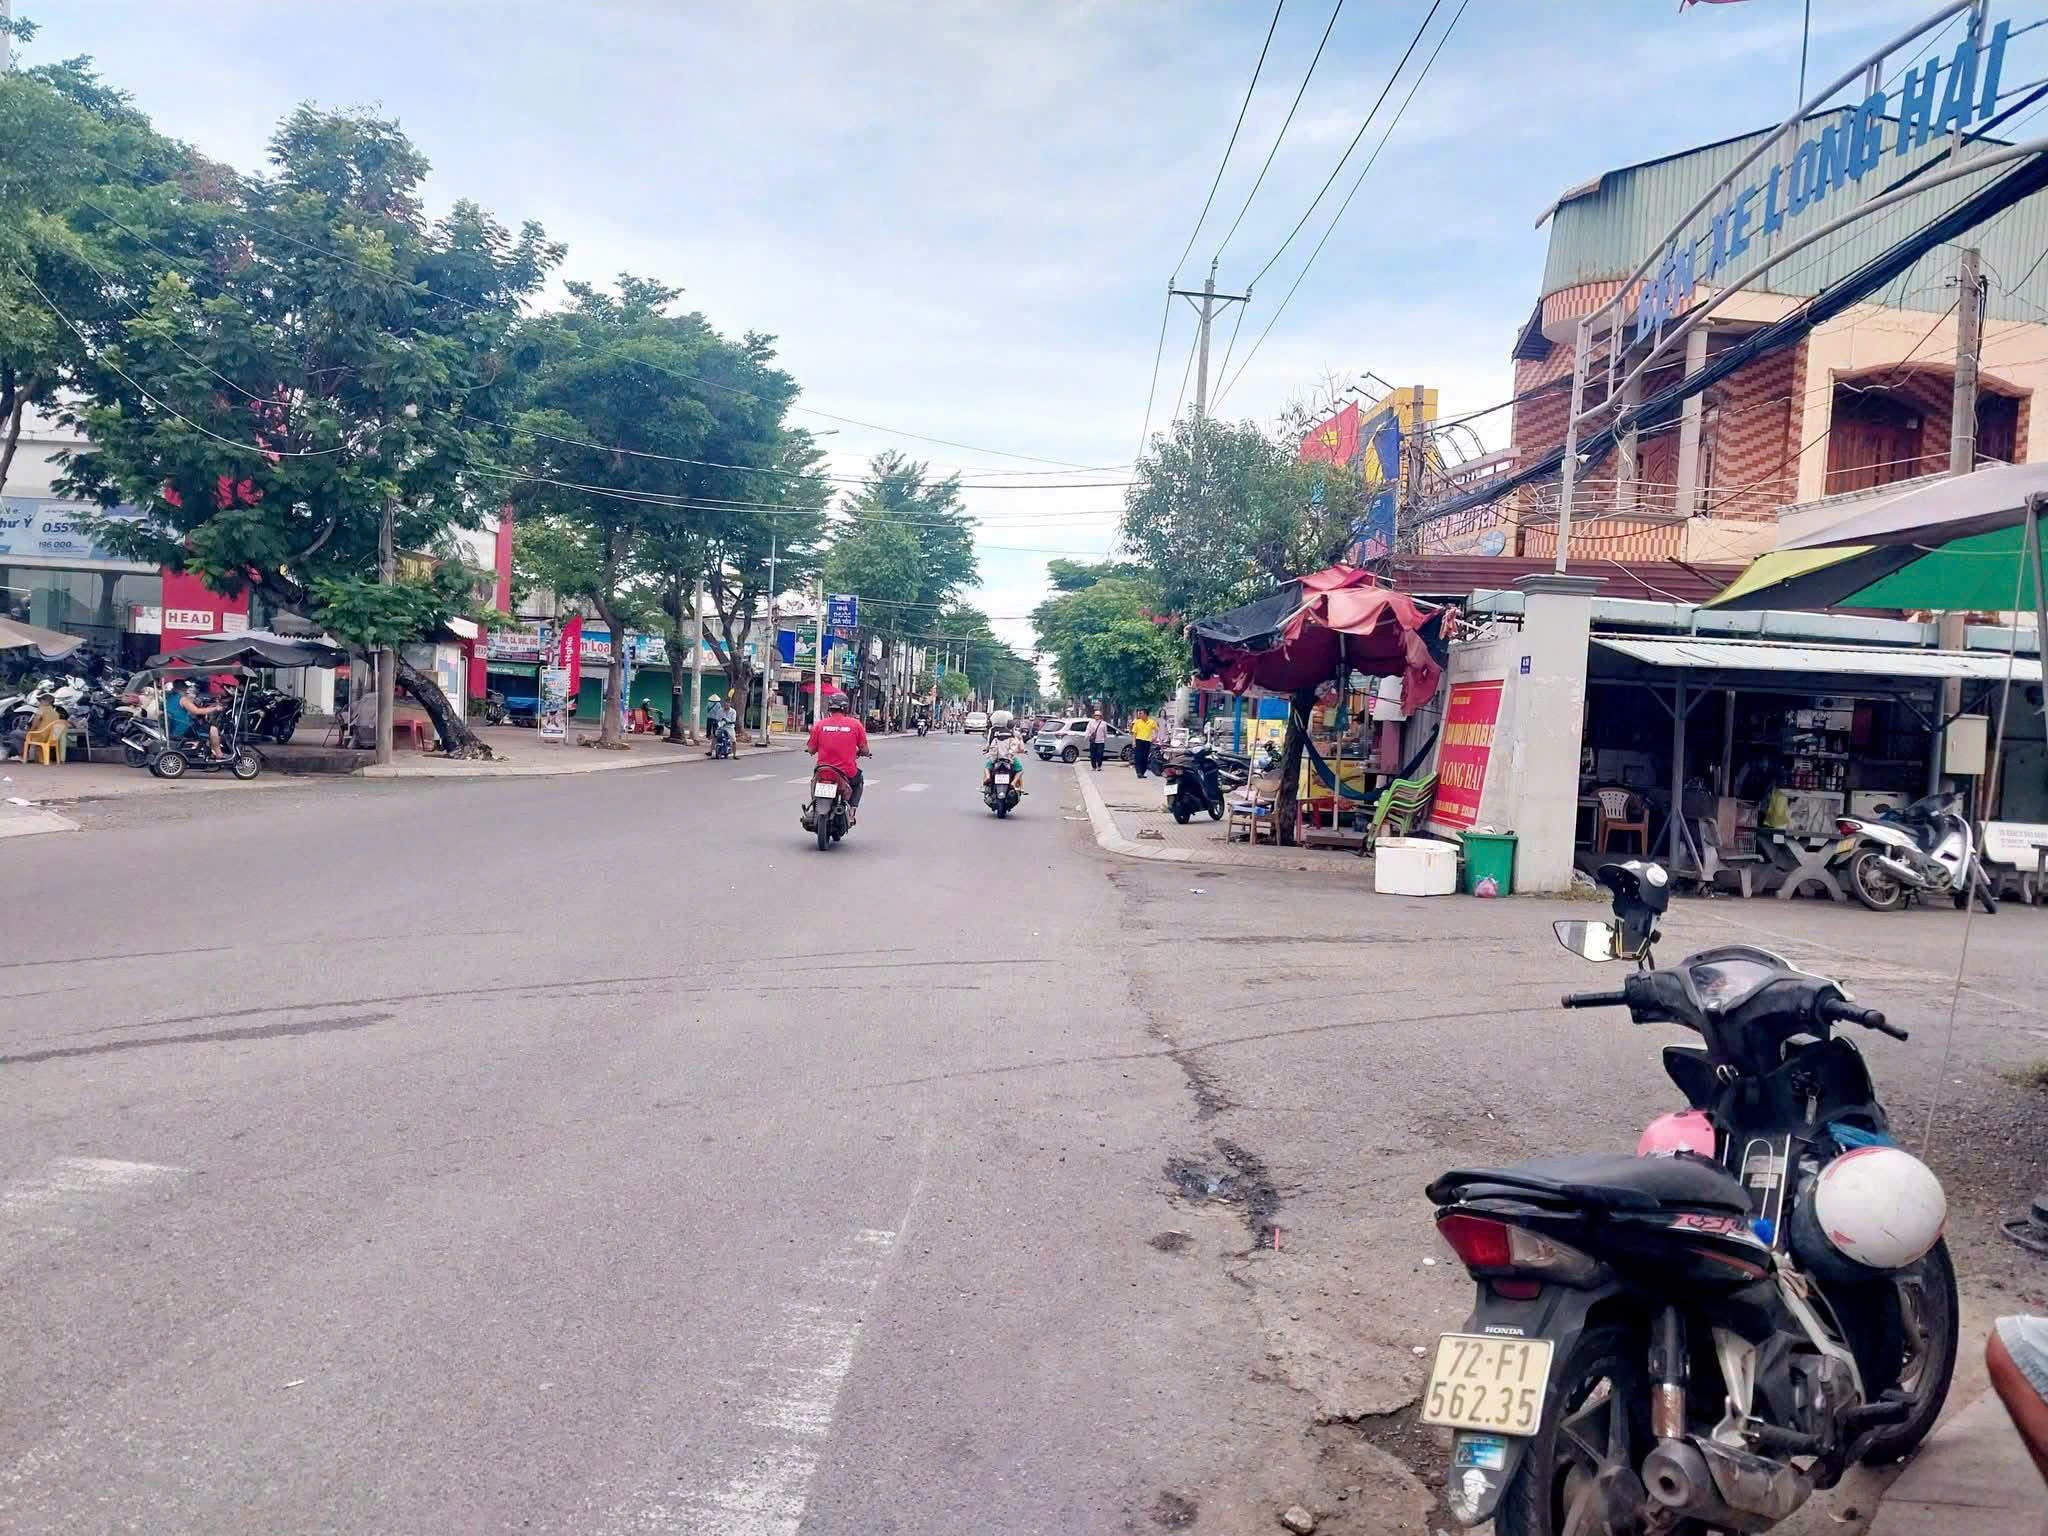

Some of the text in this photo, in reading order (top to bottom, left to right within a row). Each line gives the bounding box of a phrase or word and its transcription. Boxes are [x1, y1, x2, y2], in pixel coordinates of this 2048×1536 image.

[1638, 15, 2011, 344] BẾN XE LONG HẢI
[168, 612, 211, 624] HEAD
[1440, 761, 1465, 788] LONG
[1485, 1326, 1524, 1335] HONDA
[1429, 1381, 1536, 1427] 562.35
